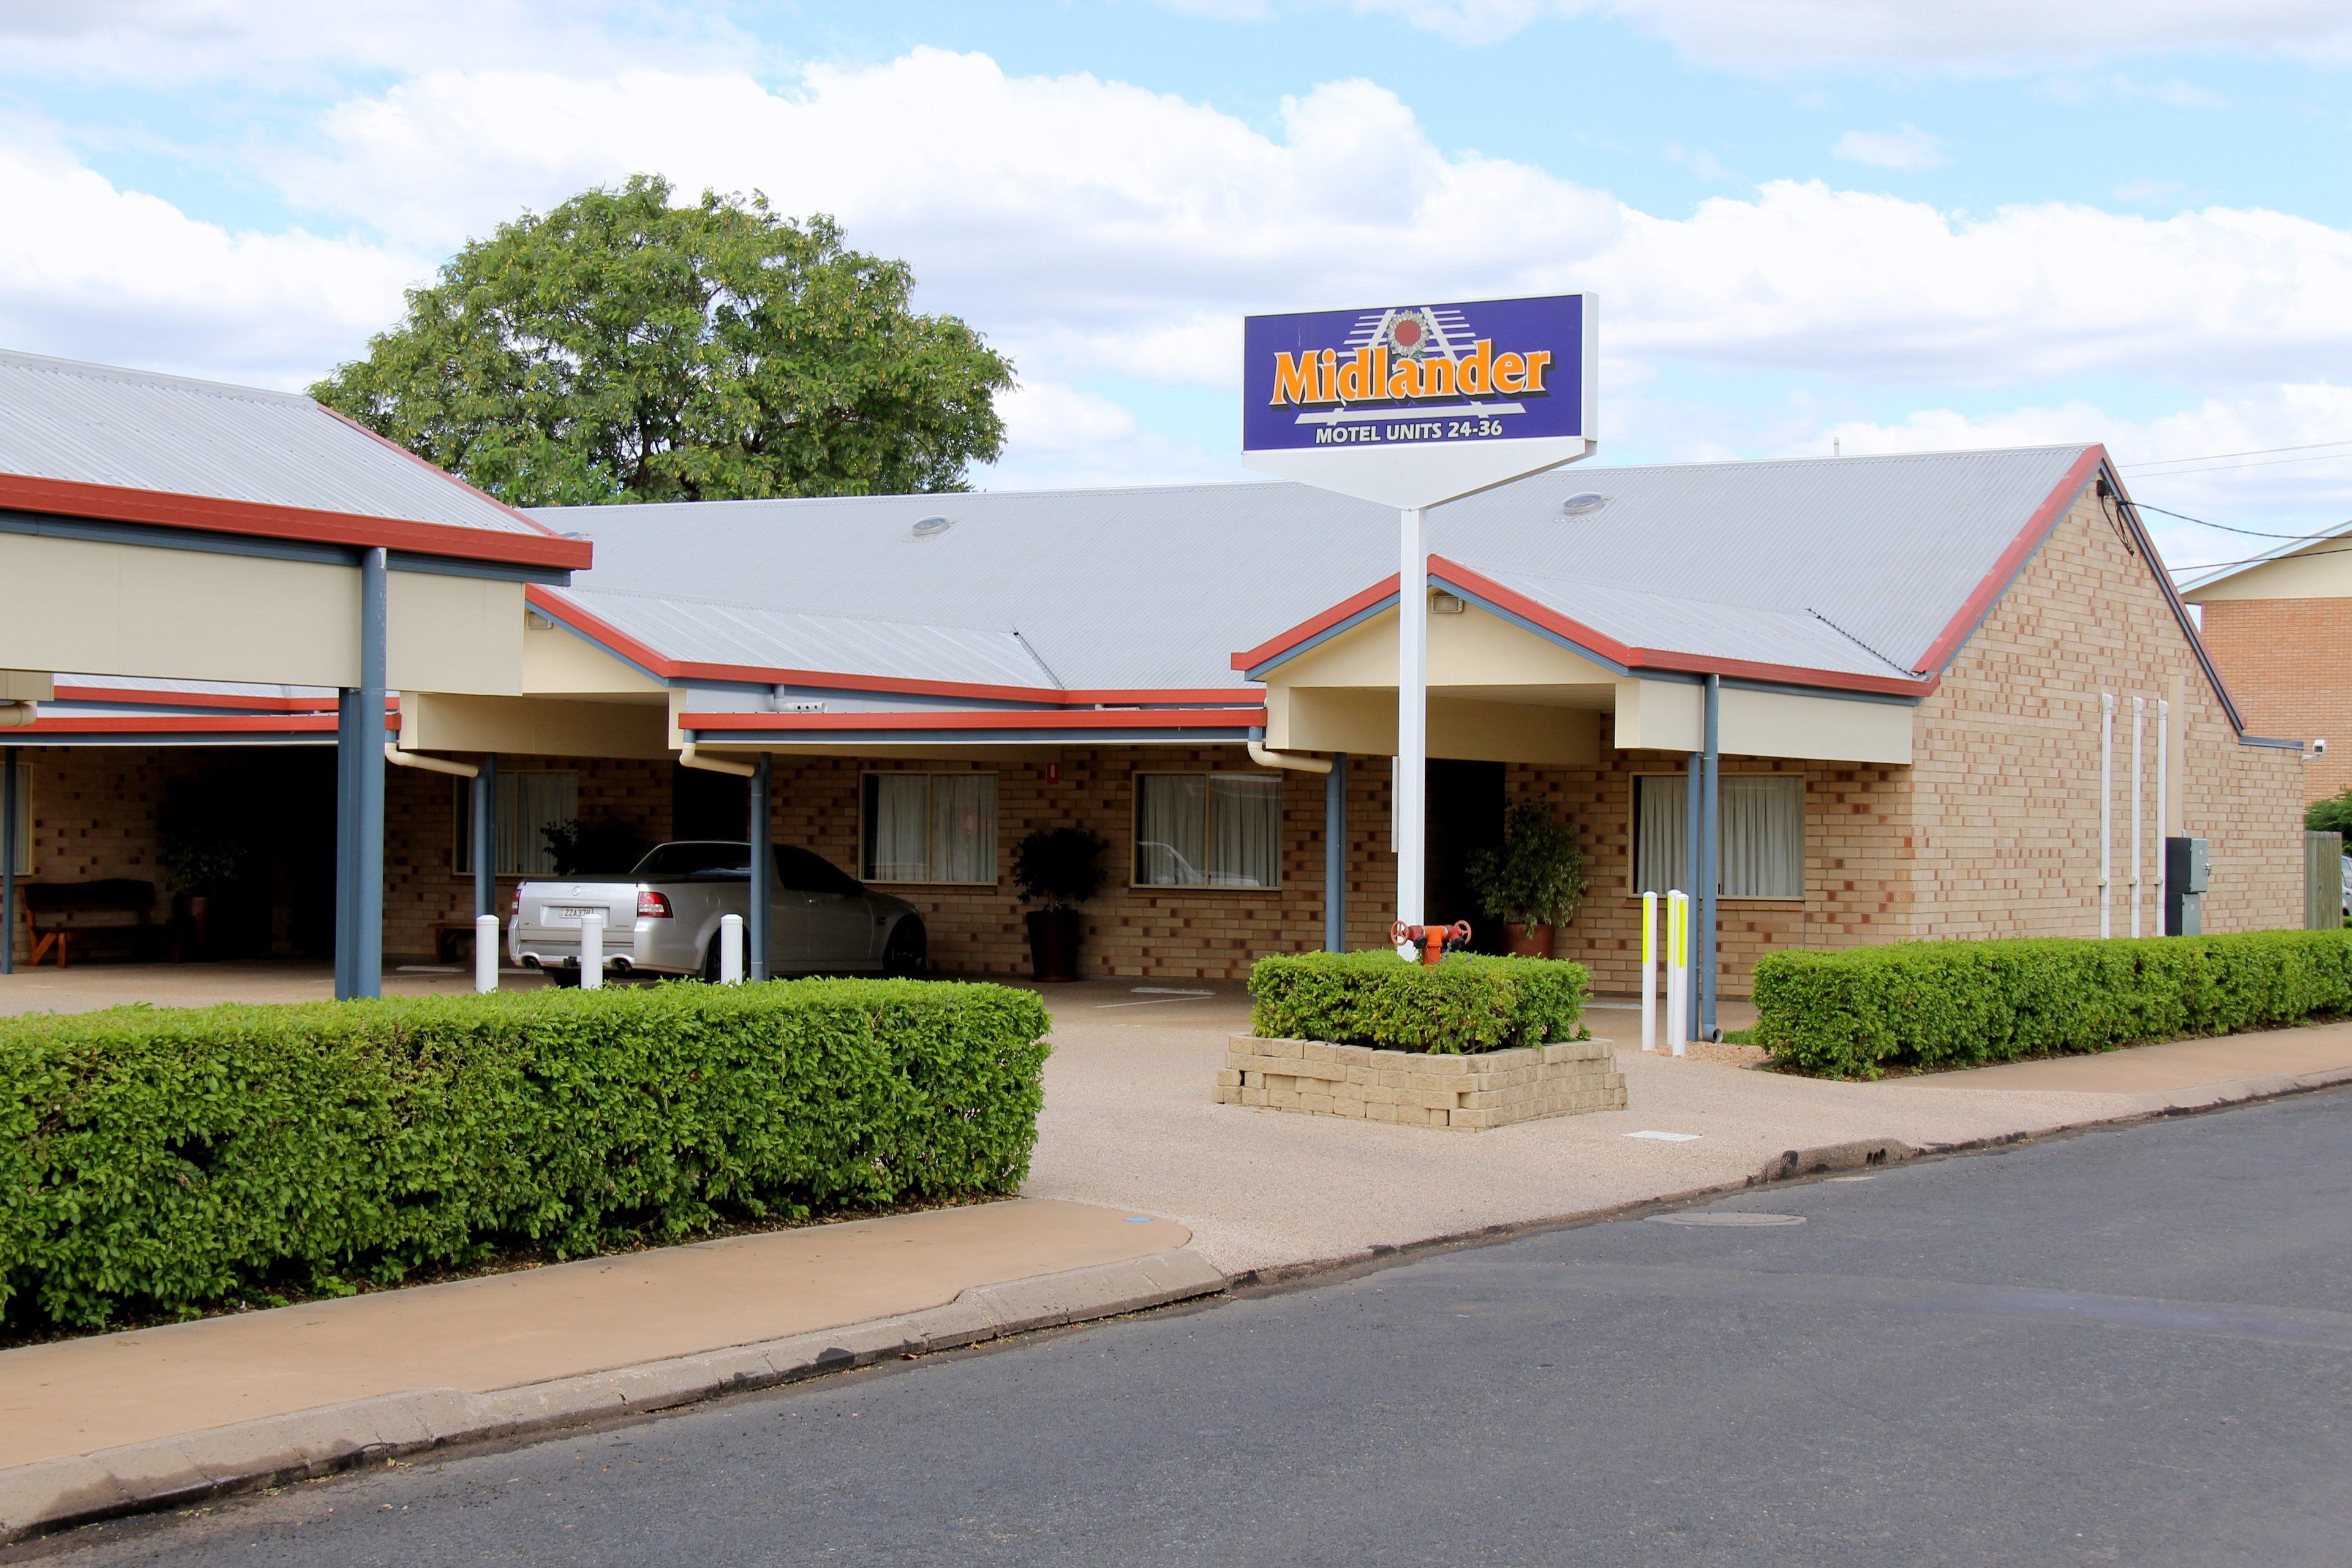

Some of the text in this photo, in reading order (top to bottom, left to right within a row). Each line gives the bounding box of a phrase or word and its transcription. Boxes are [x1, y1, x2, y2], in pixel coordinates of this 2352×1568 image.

[1269, 339, 1551, 406] Midlander
[1315, 419, 1502, 444] MOTEL UNITS 24-36
